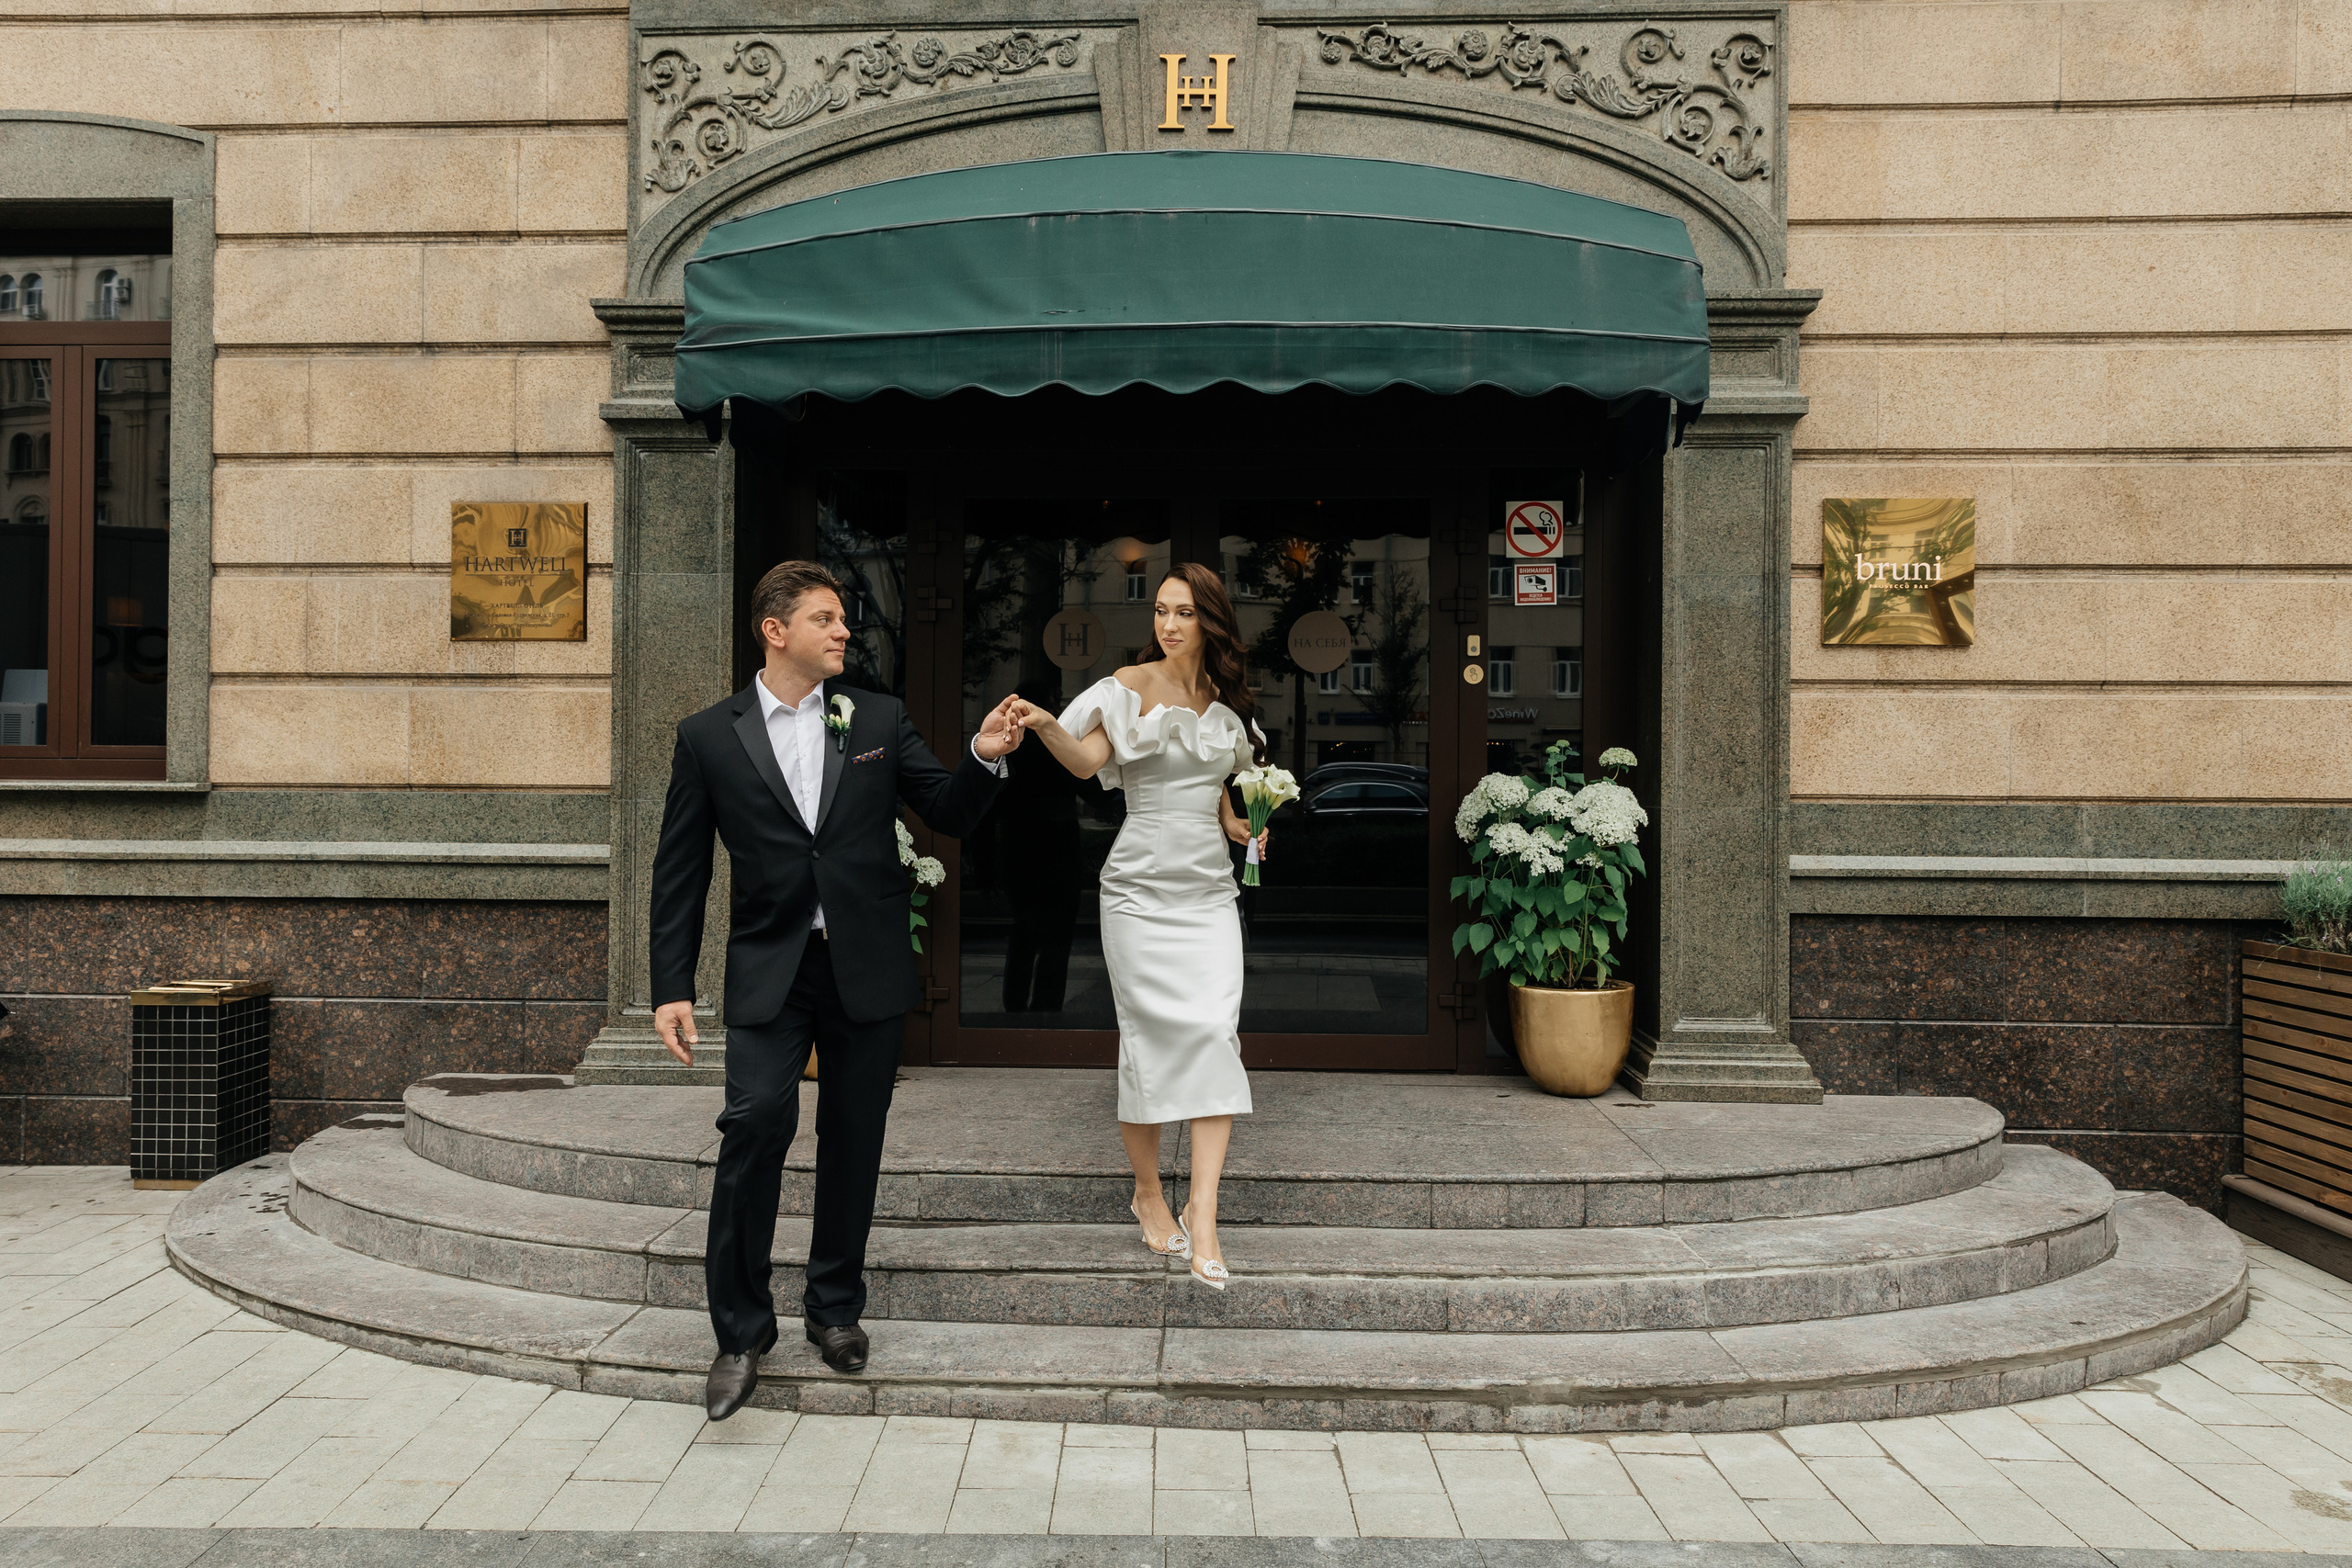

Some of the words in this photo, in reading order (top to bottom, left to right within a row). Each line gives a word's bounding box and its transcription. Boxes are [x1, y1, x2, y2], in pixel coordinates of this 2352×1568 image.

[465, 557, 571, 571] HARTWELL
[1854, 553, 1943, 581] bruni
[500, 579, 535, 587] HOTEL
[1294, 637, 1312, 648] НА
[1315, 637, 1346, 648] СЕБЯ
